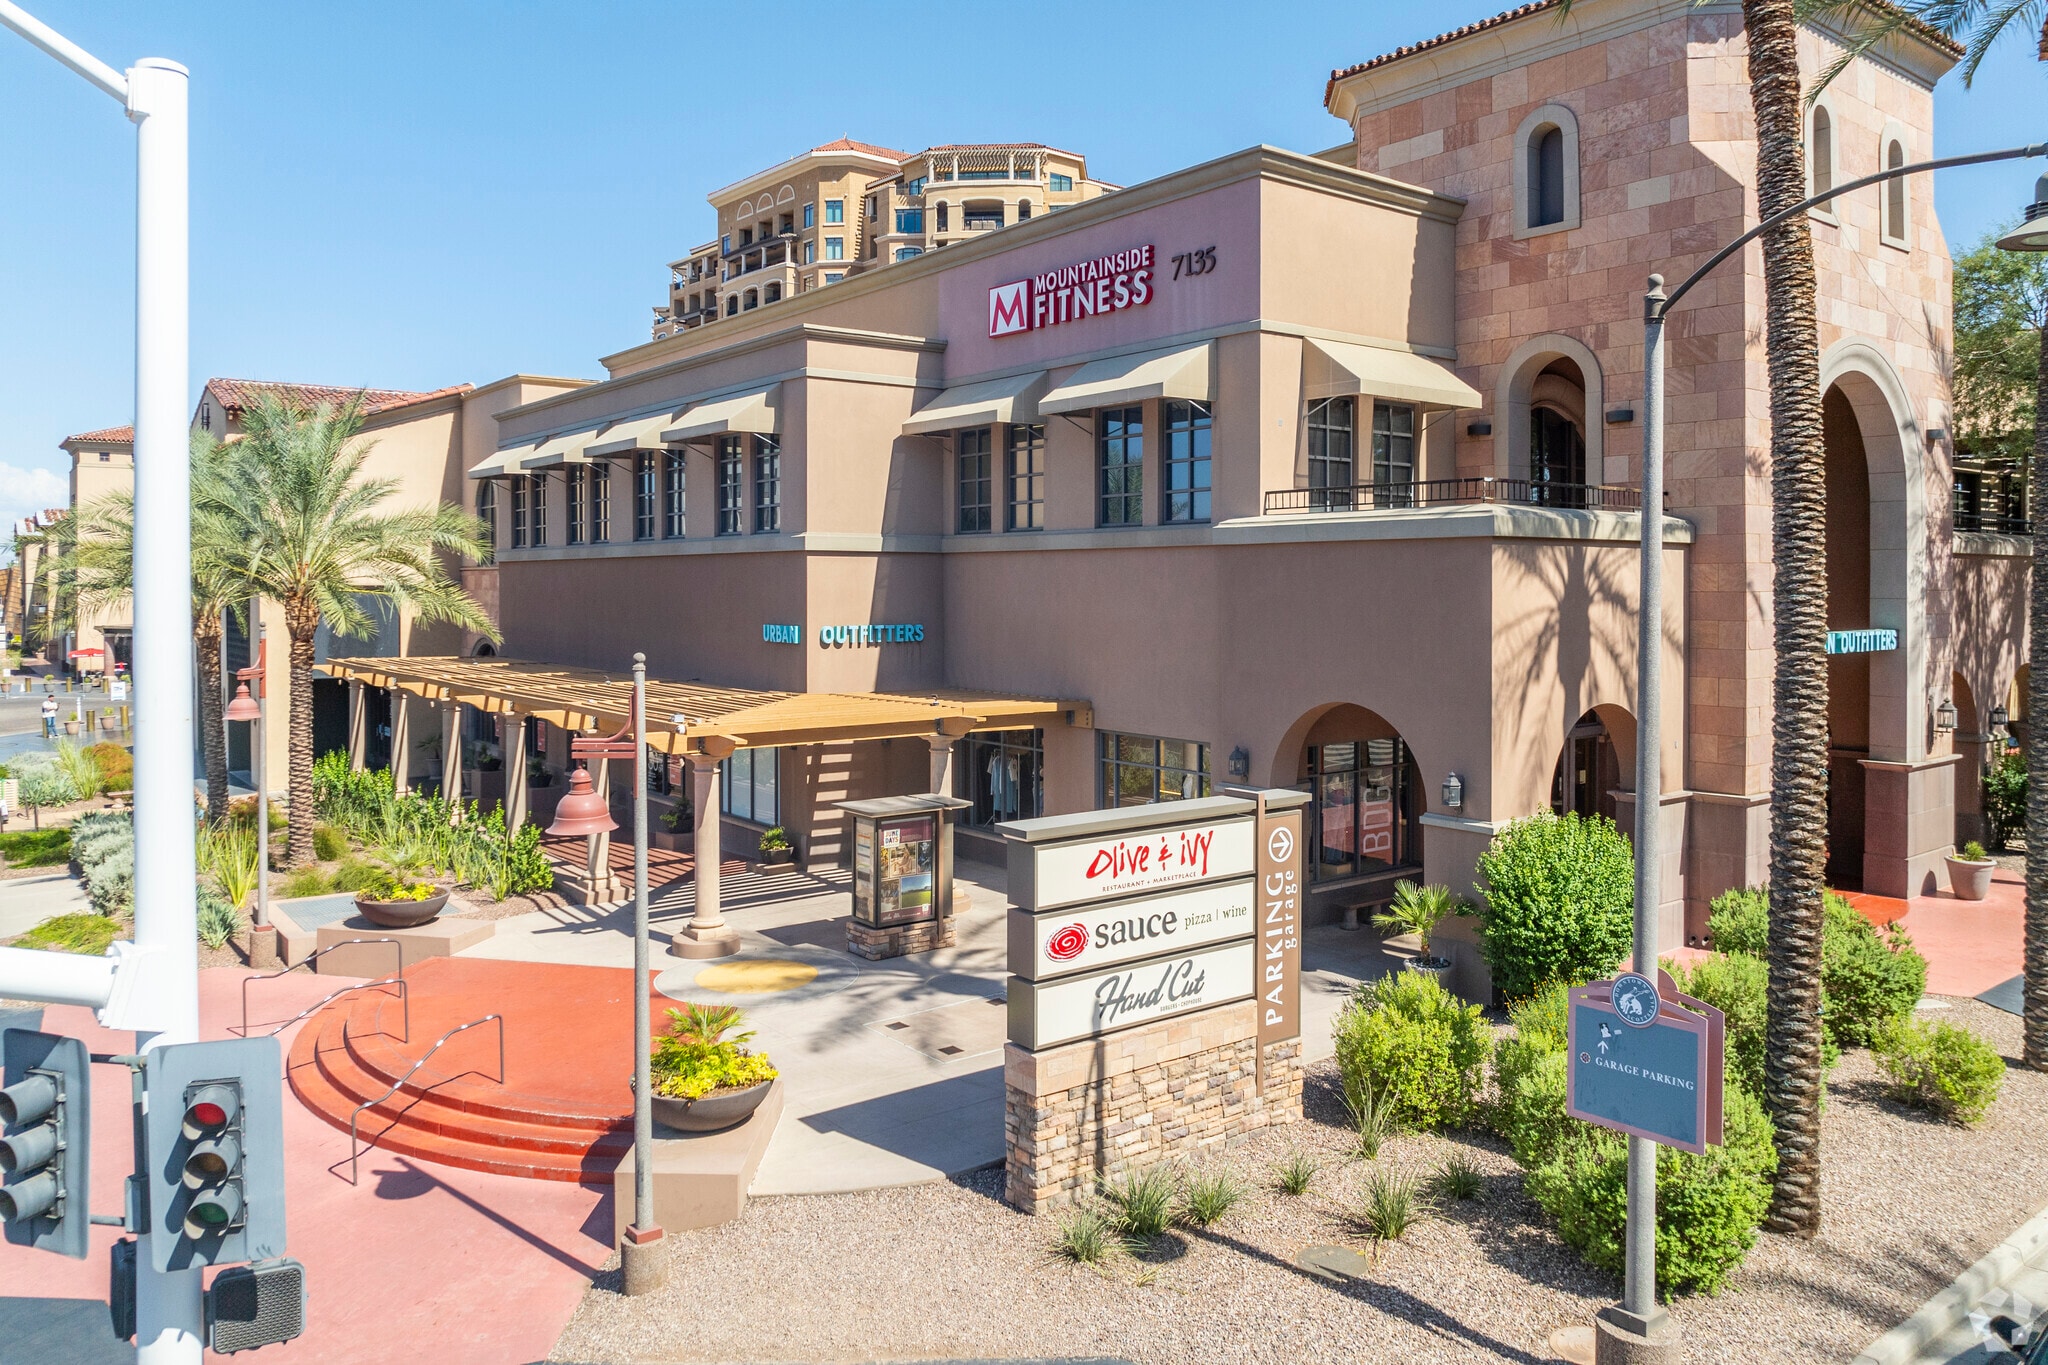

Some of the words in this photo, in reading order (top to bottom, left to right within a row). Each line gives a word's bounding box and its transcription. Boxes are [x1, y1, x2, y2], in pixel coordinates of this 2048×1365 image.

[1034, 245, 1152, 295] MOUNTAINSIDE
[1171, 246, 1217, 281] 7135
[1034, 270, 1152, 328] FITNESS
[763, 624, 800, 645] URBAN
[821, 624, 925, 645] OUTFITTERS
[1841, 629, 1898, 654] OUTFITTERS
[1363, 785, 1392, 854] BDG
[1086, 842, 1150, 879] Olive
[1158, 836, 1173, 871] &
[1102, 880, 1145, 893] RESTAURANT
[1152, 871, 1197, 884] MARKETPLACE
[1095, 911, 1178, 949] sauce
[1184, 912, 1212, 931] pizza
[1222, 905, 1248, 920] wine
[1284, 870, 1298, 949] garage
[1265, 872, 1284, 1027] PARKING
[1095, 965, 1173, 1023] Hand
[1169, 959, 1205, 1000] Cut
[1614, 979, 1647, 998] DOWNTOWN
[1627, 995, 1656, 1022] SCOTTSDALE
[1595, 1057, 1639, 1076] GARAGE
[1642, 1069, 1694, 1091] PARKING
